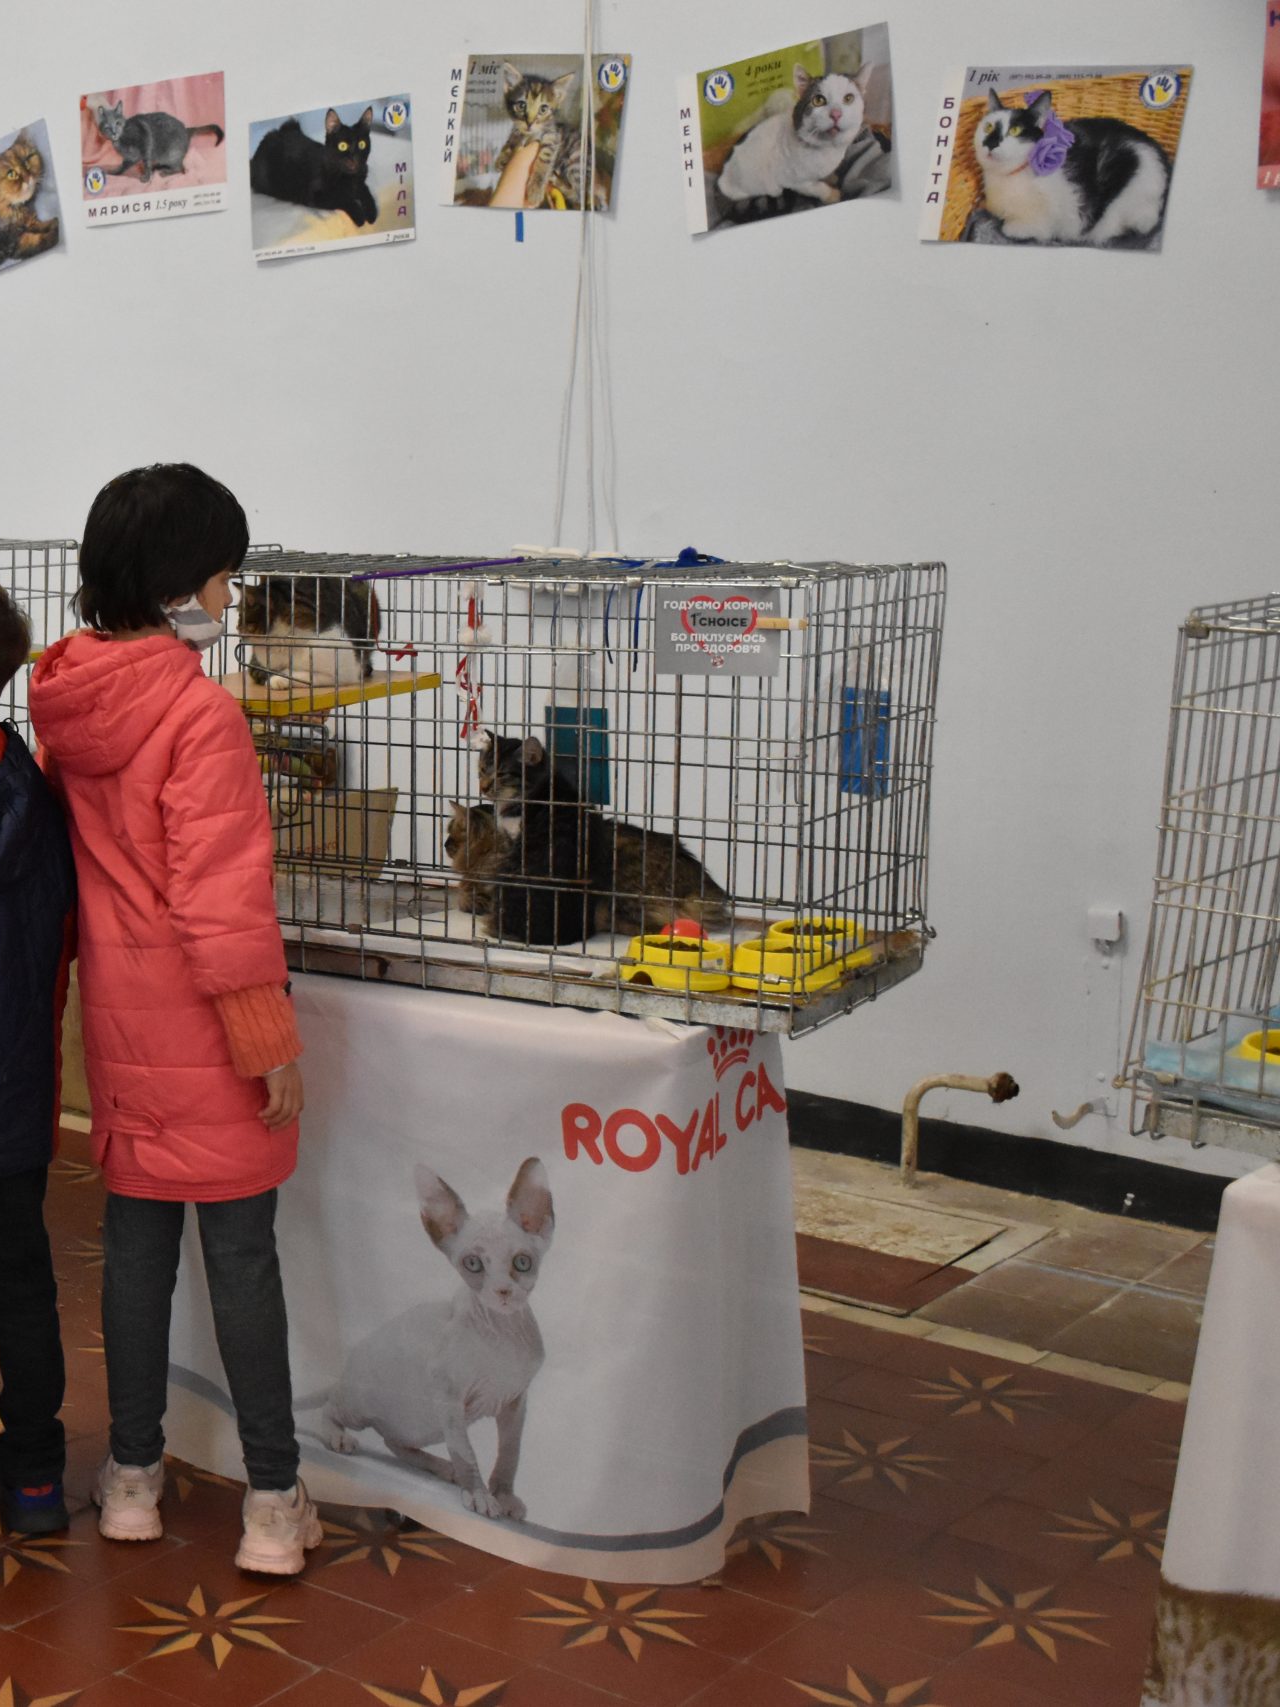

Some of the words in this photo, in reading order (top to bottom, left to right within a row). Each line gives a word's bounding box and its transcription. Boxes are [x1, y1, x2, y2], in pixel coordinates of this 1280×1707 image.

[753, 61, 782, 79] роки
[978, 69, 1001, 85] рік
[443, 68, 462, 163] МЄЛКИЙ
[680, 107, 693, 188] МЕННІ
[926, 97, 955, 203] БОНІТА
[395, 162, 407, 217] МІЛА
[88, 201, 151, 218] МАРИСЯ
[663, 600, 721, 611] ГОДУЄМО
[723, 600, 774, 611] КОРМОМ
[699, 617, 748, 628] CHOICE
[670, 632, 688, 642] БО
[690, 632, 767, 643] ПІКЛУЄМОСЬ
[675, 643, 700, 653] ПРО
[702, 643, 761, 654] ЗДОРОВ'Я
[561, 1091, 728, 1176] ROYAL
